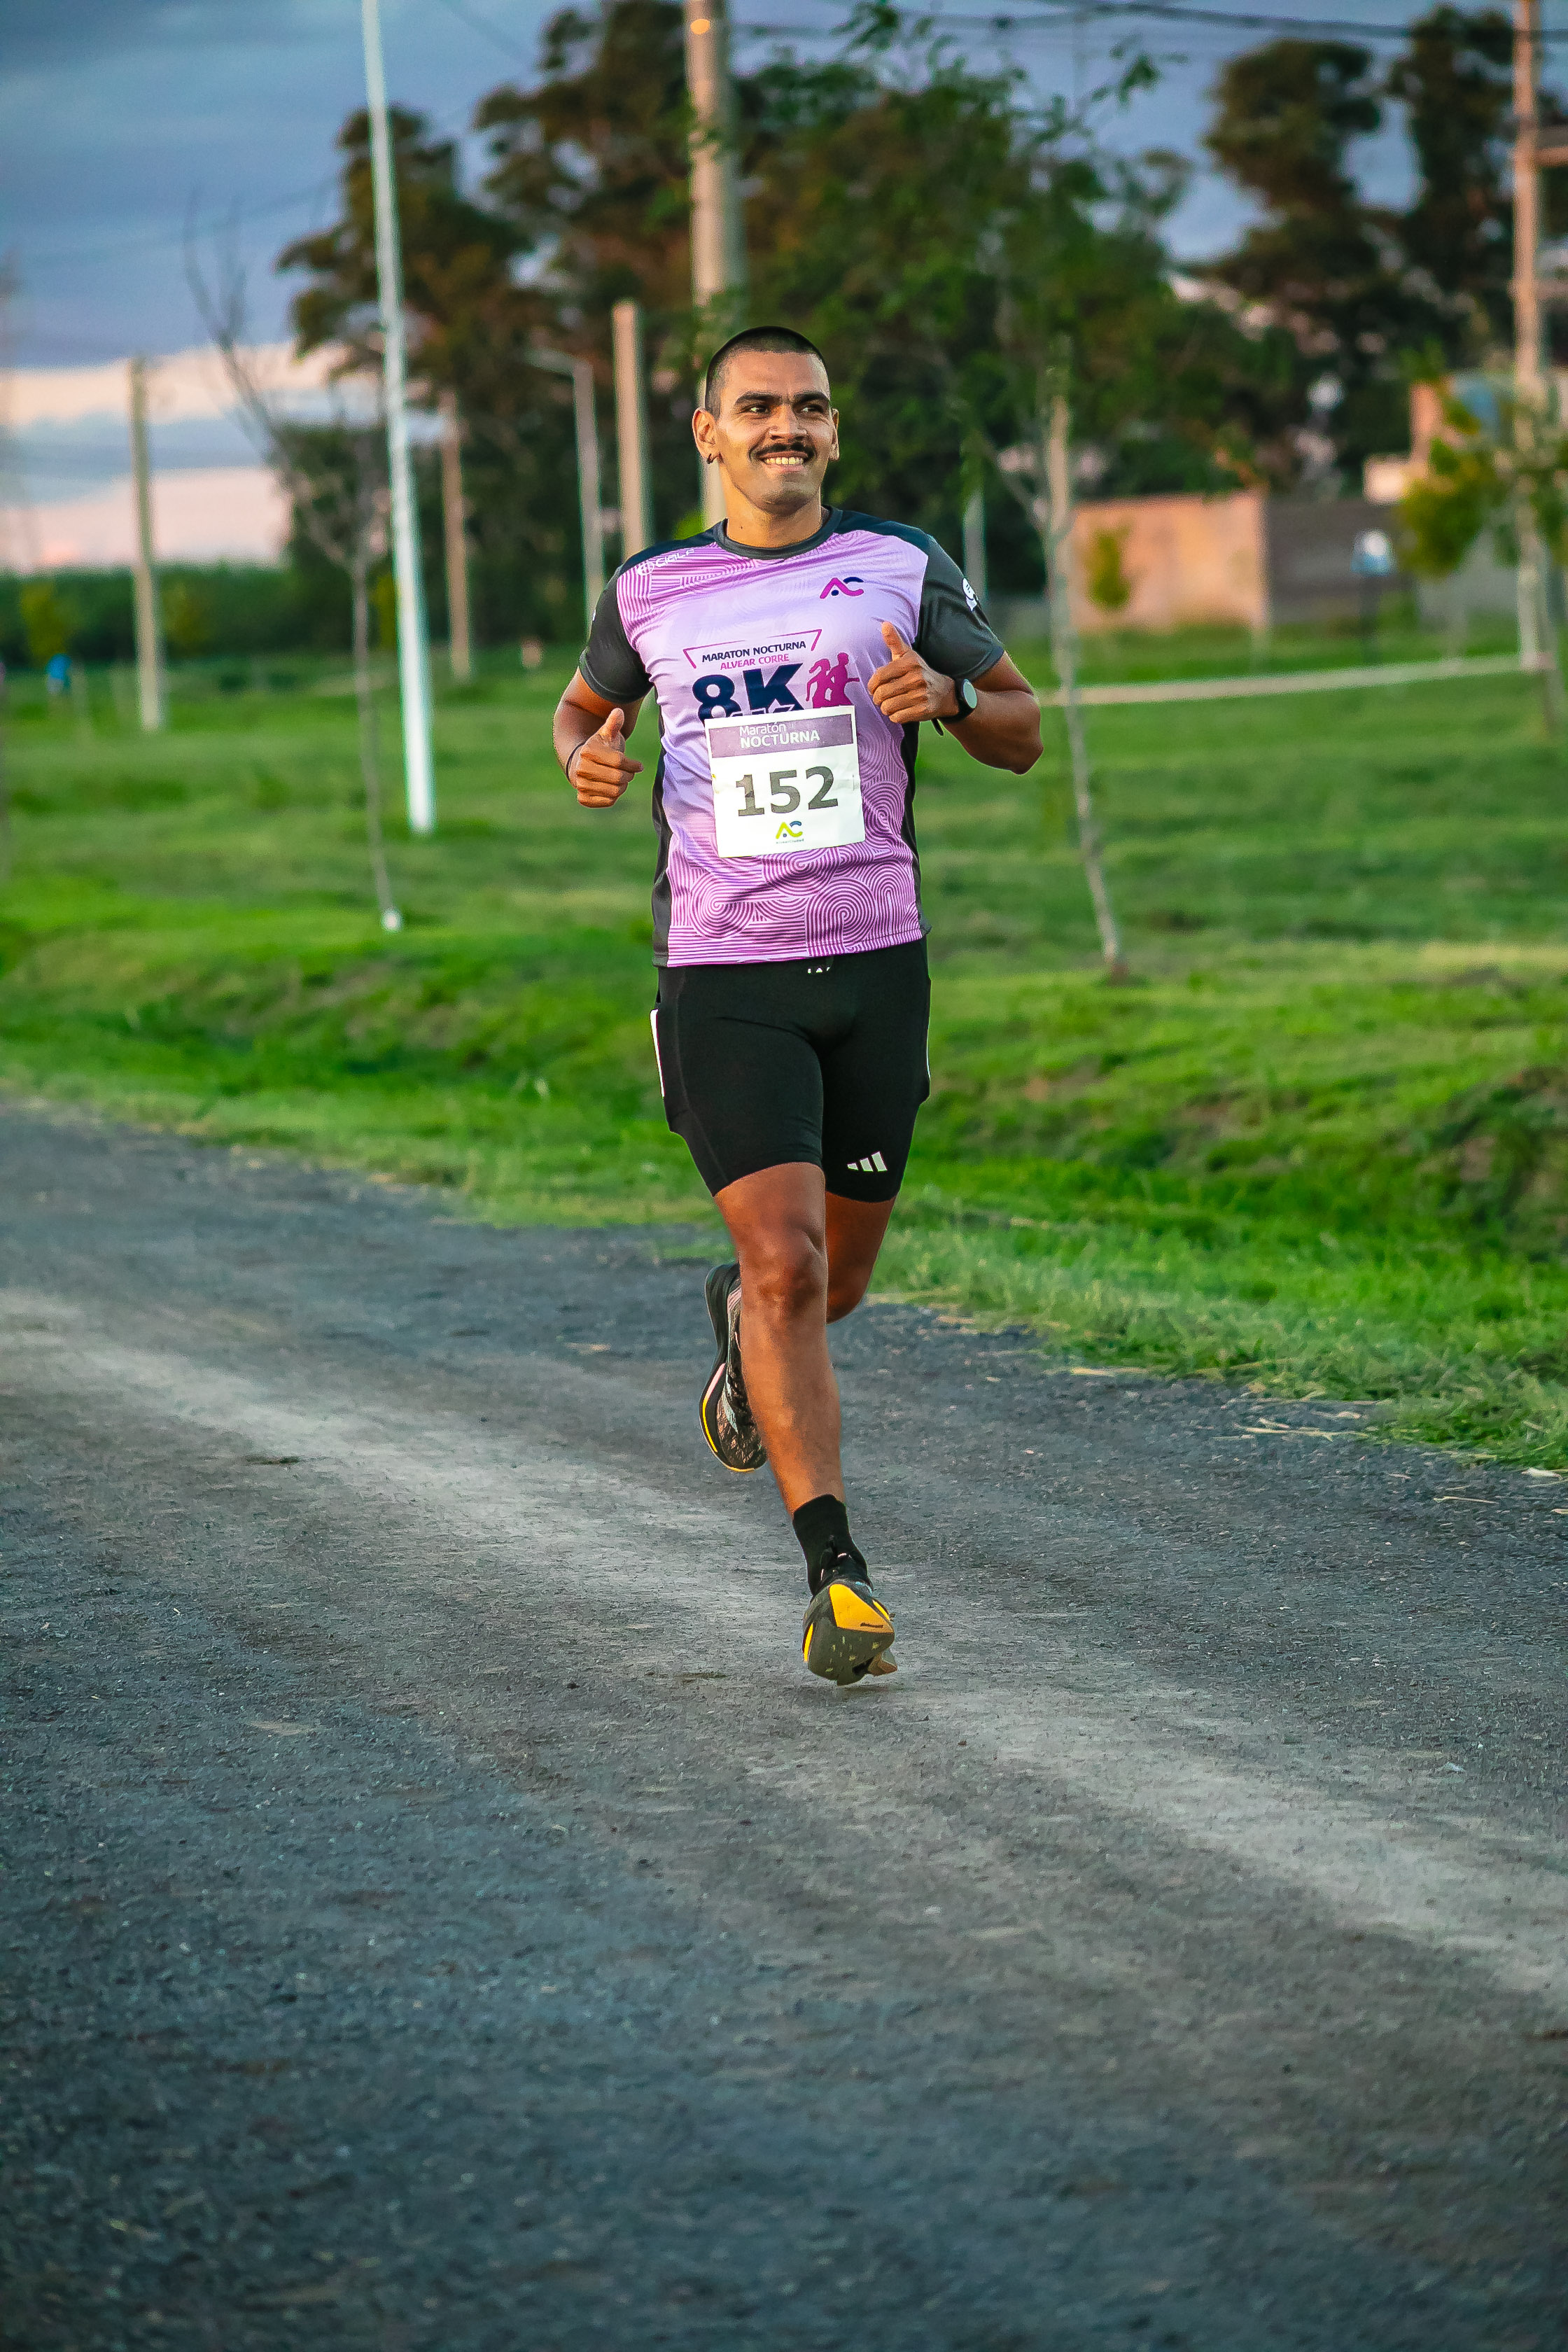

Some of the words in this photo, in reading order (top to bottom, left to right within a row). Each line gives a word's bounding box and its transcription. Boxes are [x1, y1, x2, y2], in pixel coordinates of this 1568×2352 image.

[701, 648, 750, 663] MARATON
[752, 640, 806, 655] NOCTURNA
[720, 658, 756, 670] ALVEAR
[758, 654, 790, 664] CORRE
[692, 663, 805, 722] 8K
[739, 721, 787, 736] Maratón
[740, 729, 820, 749] NOCTURNA
[736, 766, 839, 816] 152
